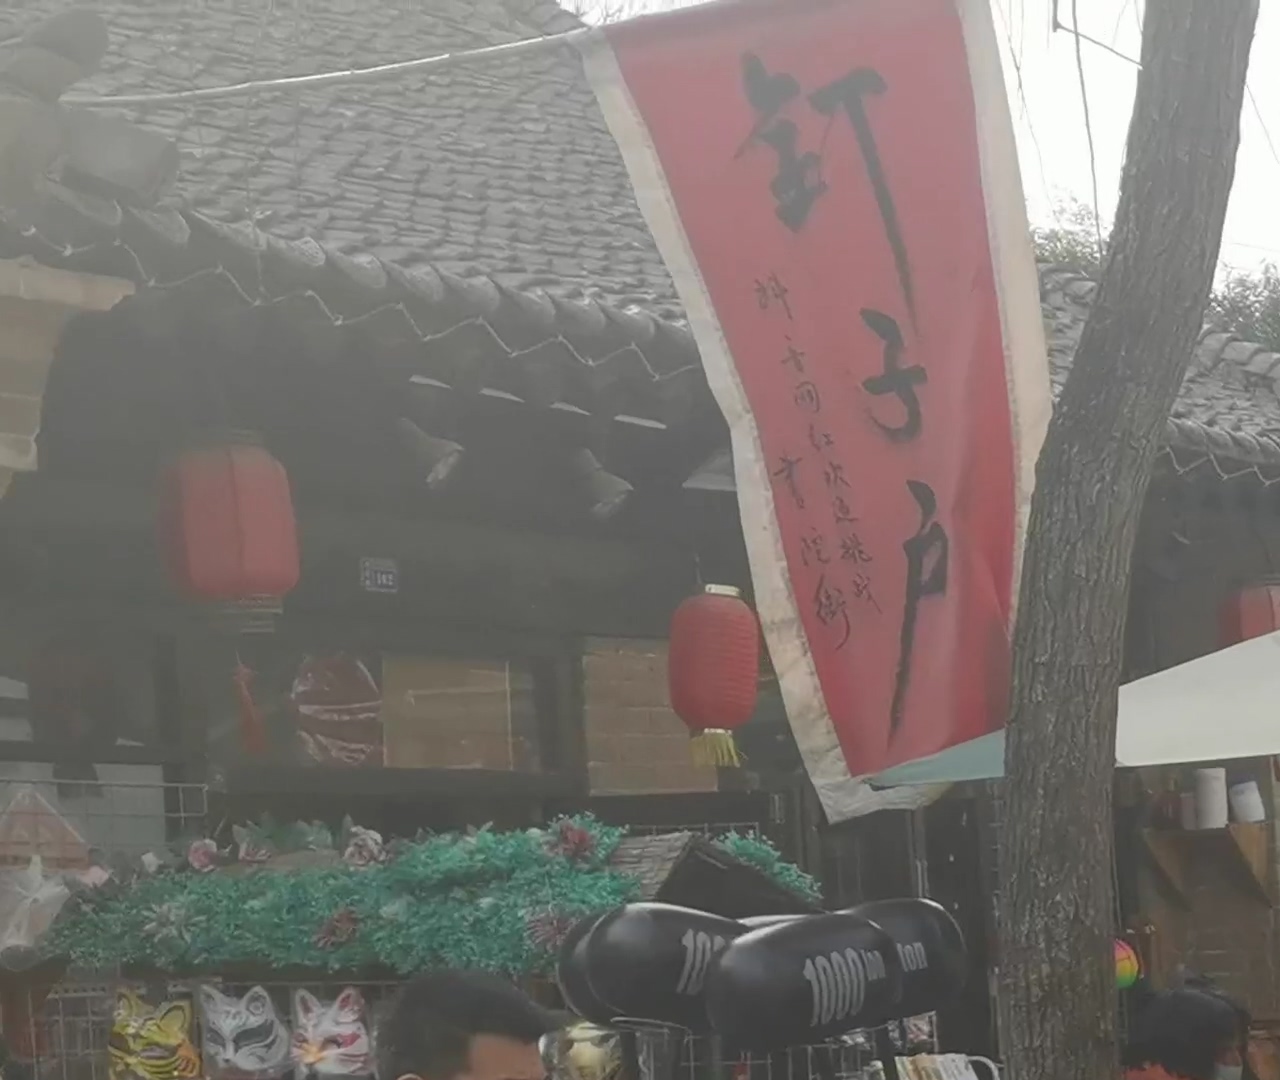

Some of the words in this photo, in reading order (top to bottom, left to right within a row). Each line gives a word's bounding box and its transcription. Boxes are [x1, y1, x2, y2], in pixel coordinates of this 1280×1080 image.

[735, 50, 948, 752] 钉子户
[803, 947, 866, 1027] 1000
